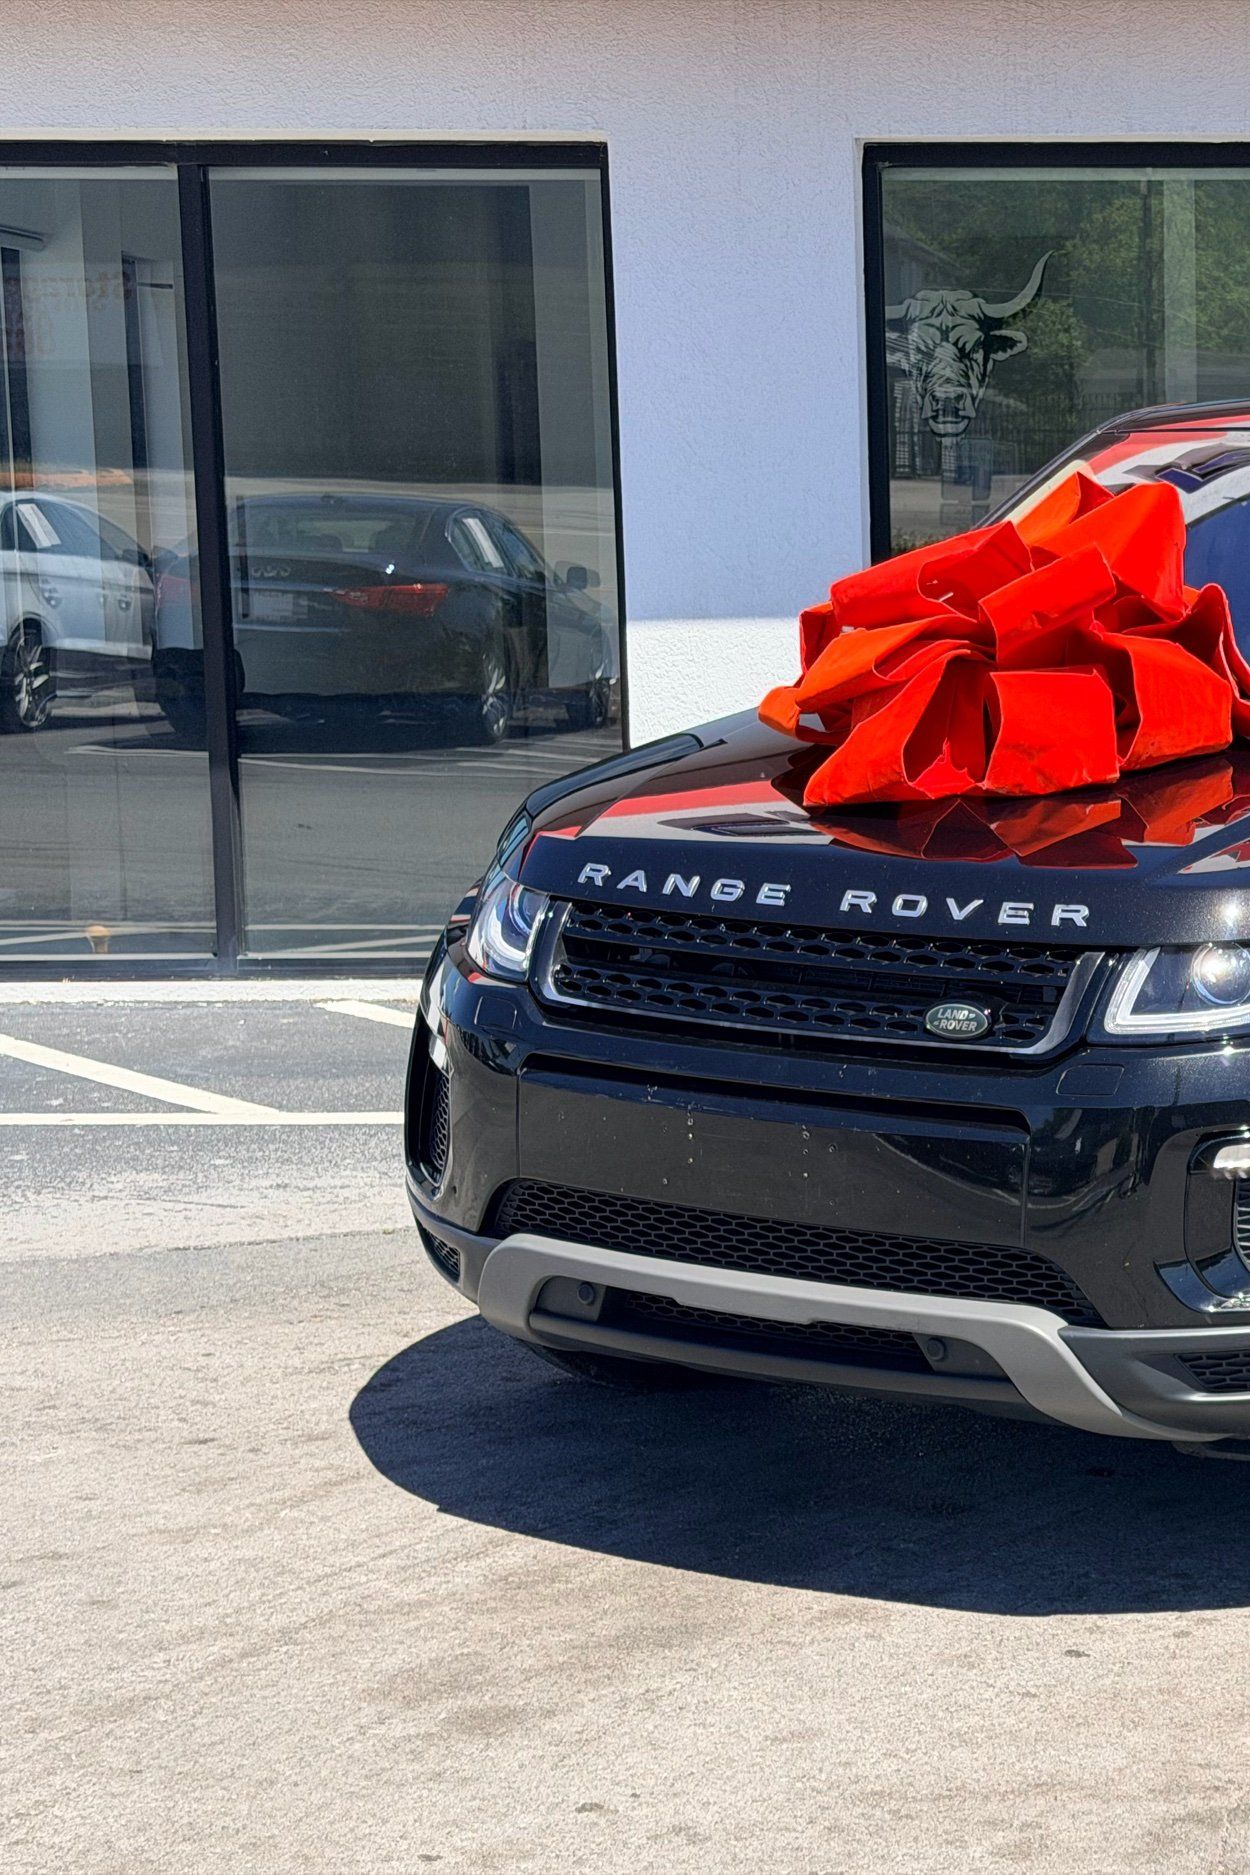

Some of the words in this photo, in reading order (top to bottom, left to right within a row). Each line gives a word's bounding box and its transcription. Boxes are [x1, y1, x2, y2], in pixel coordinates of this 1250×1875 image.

[577, 862, 793, 907] RANGE
[838, 888, 1091, 929] ROVER
[937, 1008, 969, 1020] LAND
[939, 1020, 978, 1032] ROVER
